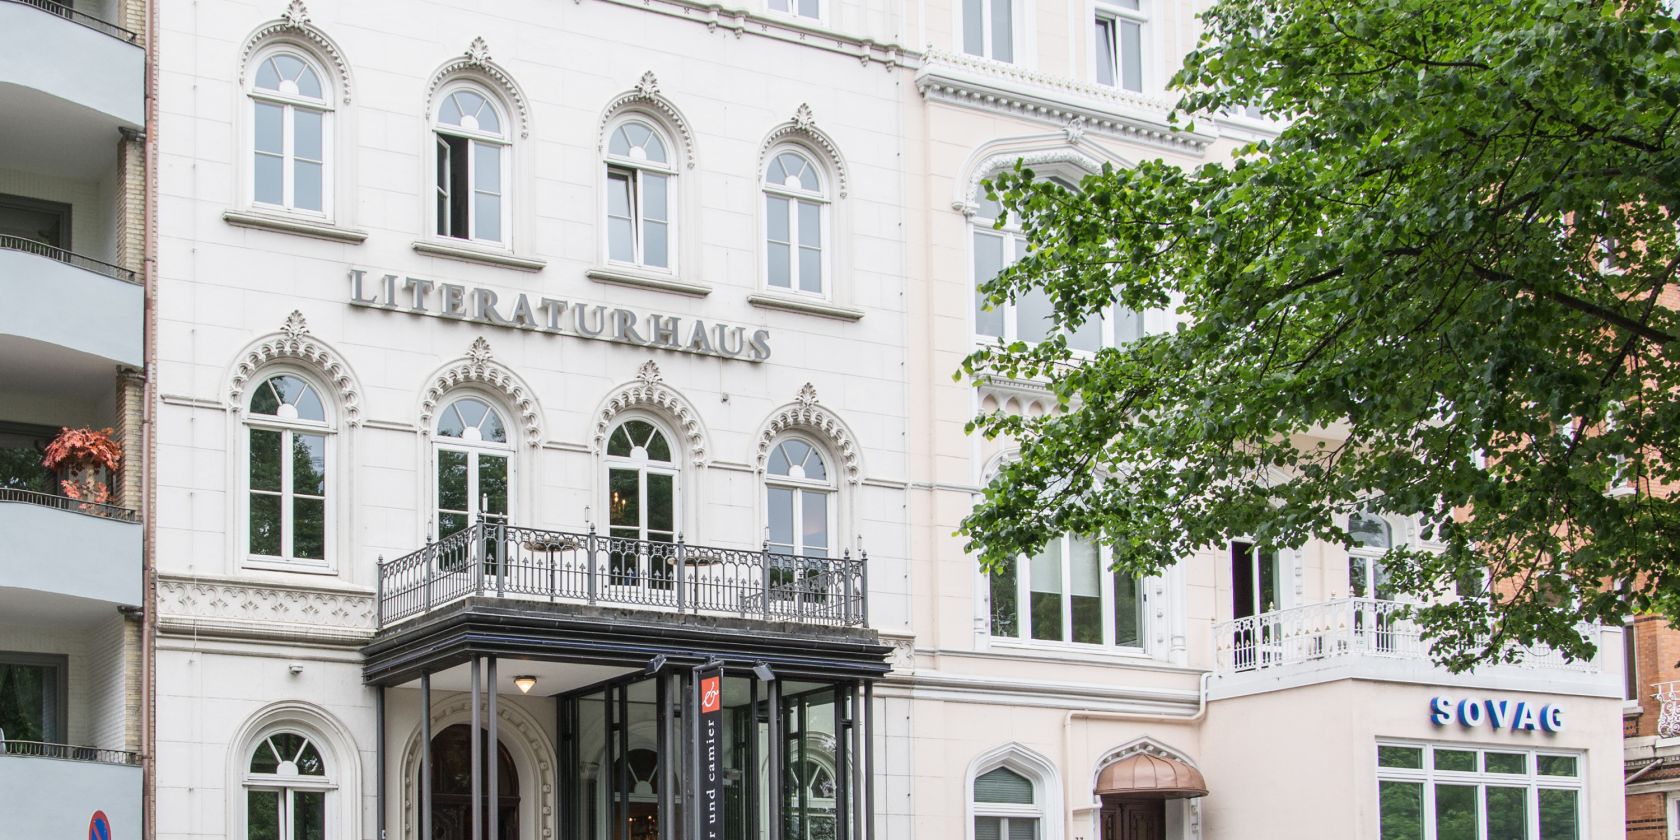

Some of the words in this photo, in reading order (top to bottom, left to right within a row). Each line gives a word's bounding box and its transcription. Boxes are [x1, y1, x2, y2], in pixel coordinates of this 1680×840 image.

[350, 268, 771, 361] LITERATURHAUS
[1430, 695, 1566, 733] SOVAG
[706, 719, 715, 782] camier
[706, 788, 715, 824] und
